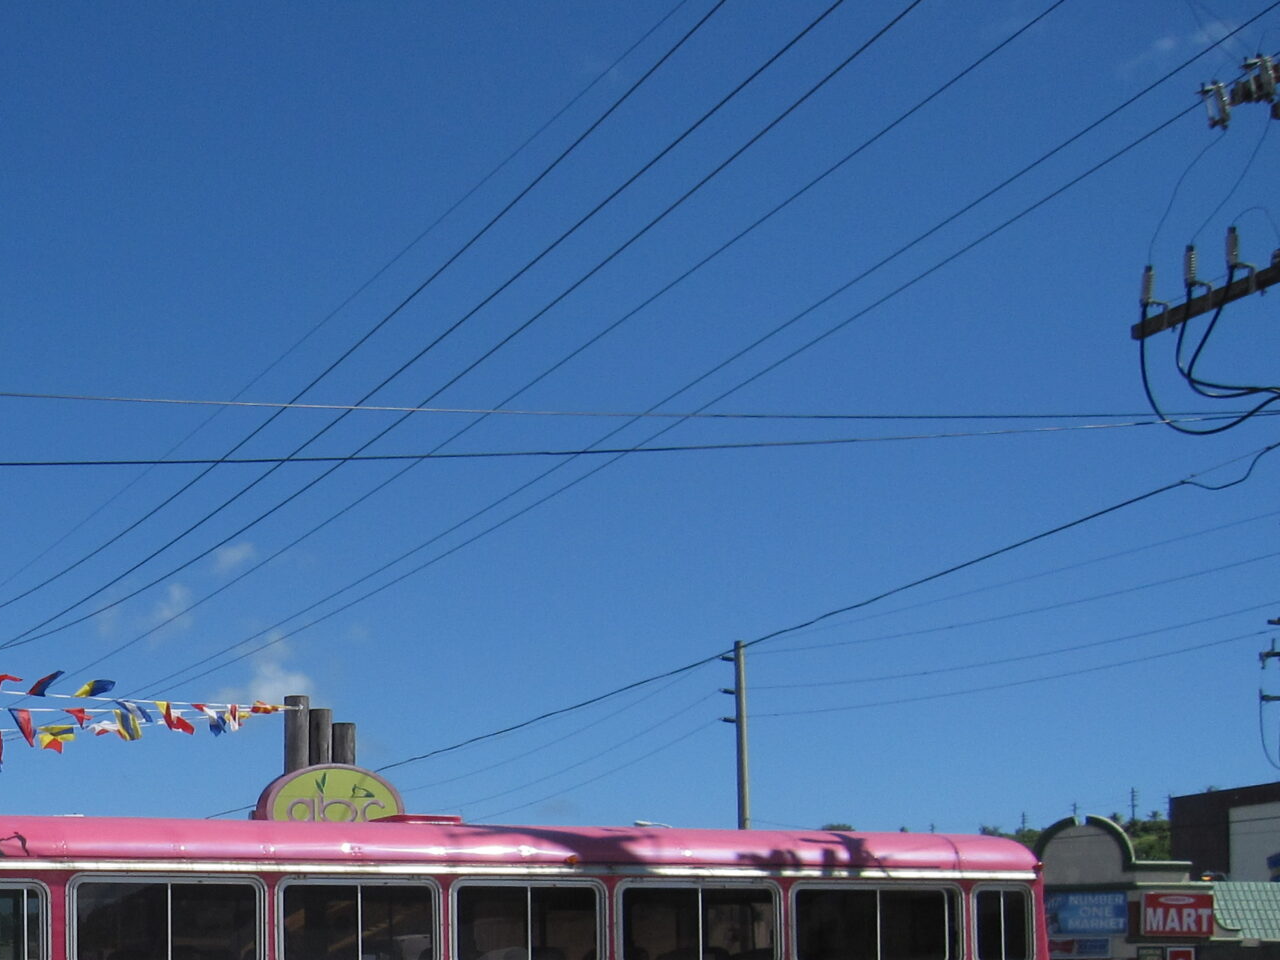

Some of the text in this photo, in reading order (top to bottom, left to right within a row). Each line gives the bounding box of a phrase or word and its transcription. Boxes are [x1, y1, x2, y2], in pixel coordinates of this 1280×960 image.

[1068, 893, 1124, 905] NUMBER
[1079, 906, 1114, 917] ONE
[1068, 917, 1127, 930] MARKET
[1145, 907, 1212, 932] MART
